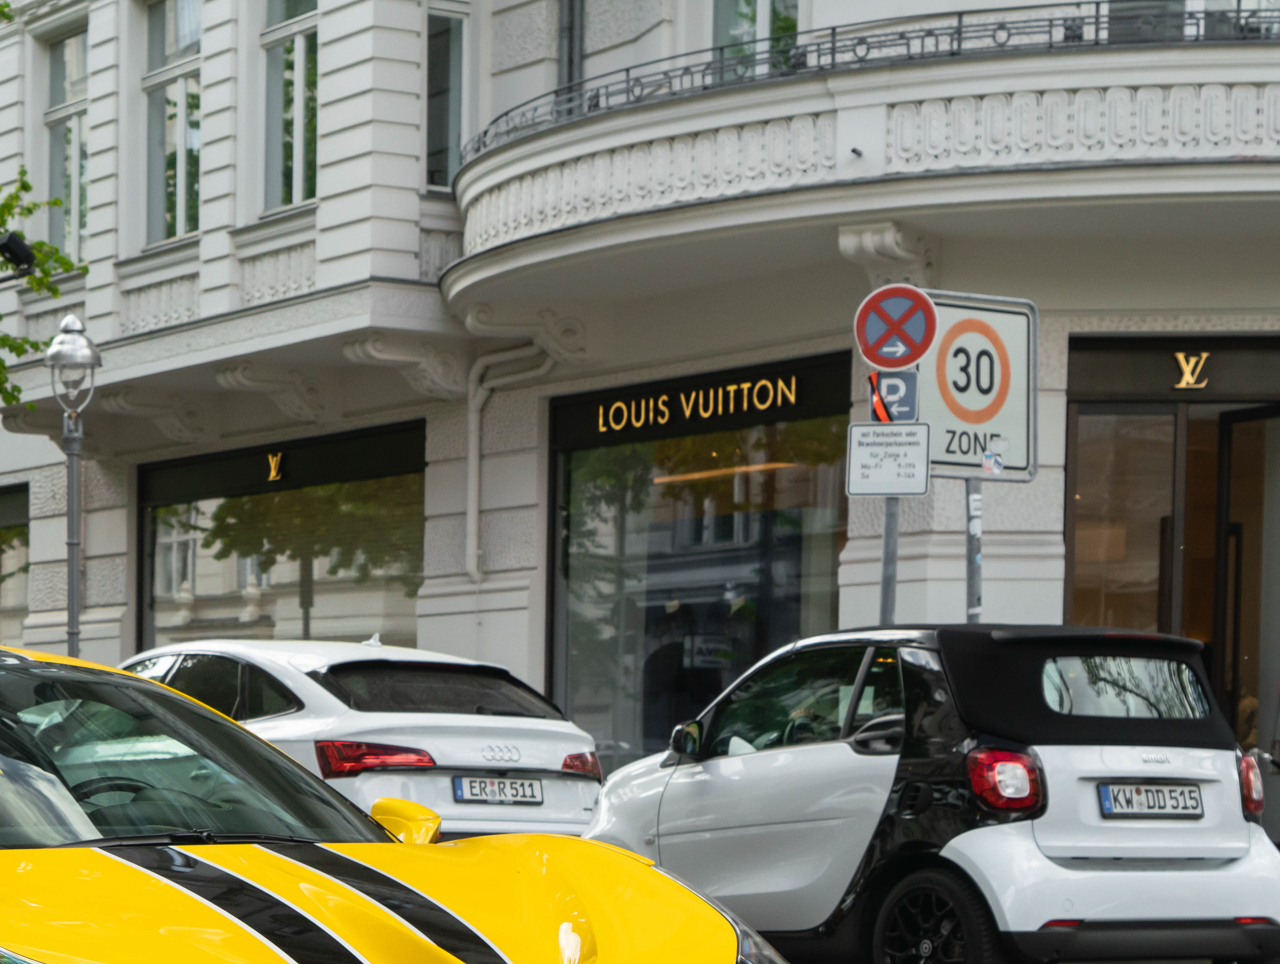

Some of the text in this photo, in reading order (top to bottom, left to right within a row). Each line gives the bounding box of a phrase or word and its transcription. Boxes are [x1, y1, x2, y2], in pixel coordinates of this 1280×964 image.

[952, 346, 995, 395] 30
[598, 375, 797, 432] LOUIS VUITTON
[469, 780, 488, 797] ER
[498, 780, 508, 798] R
[509, 781, 537, 799] 511
[1111, 787, 1134, 810] KW
[1144, 788, 1167, 810] DD
[1168, 789, 1200, 811] 515
